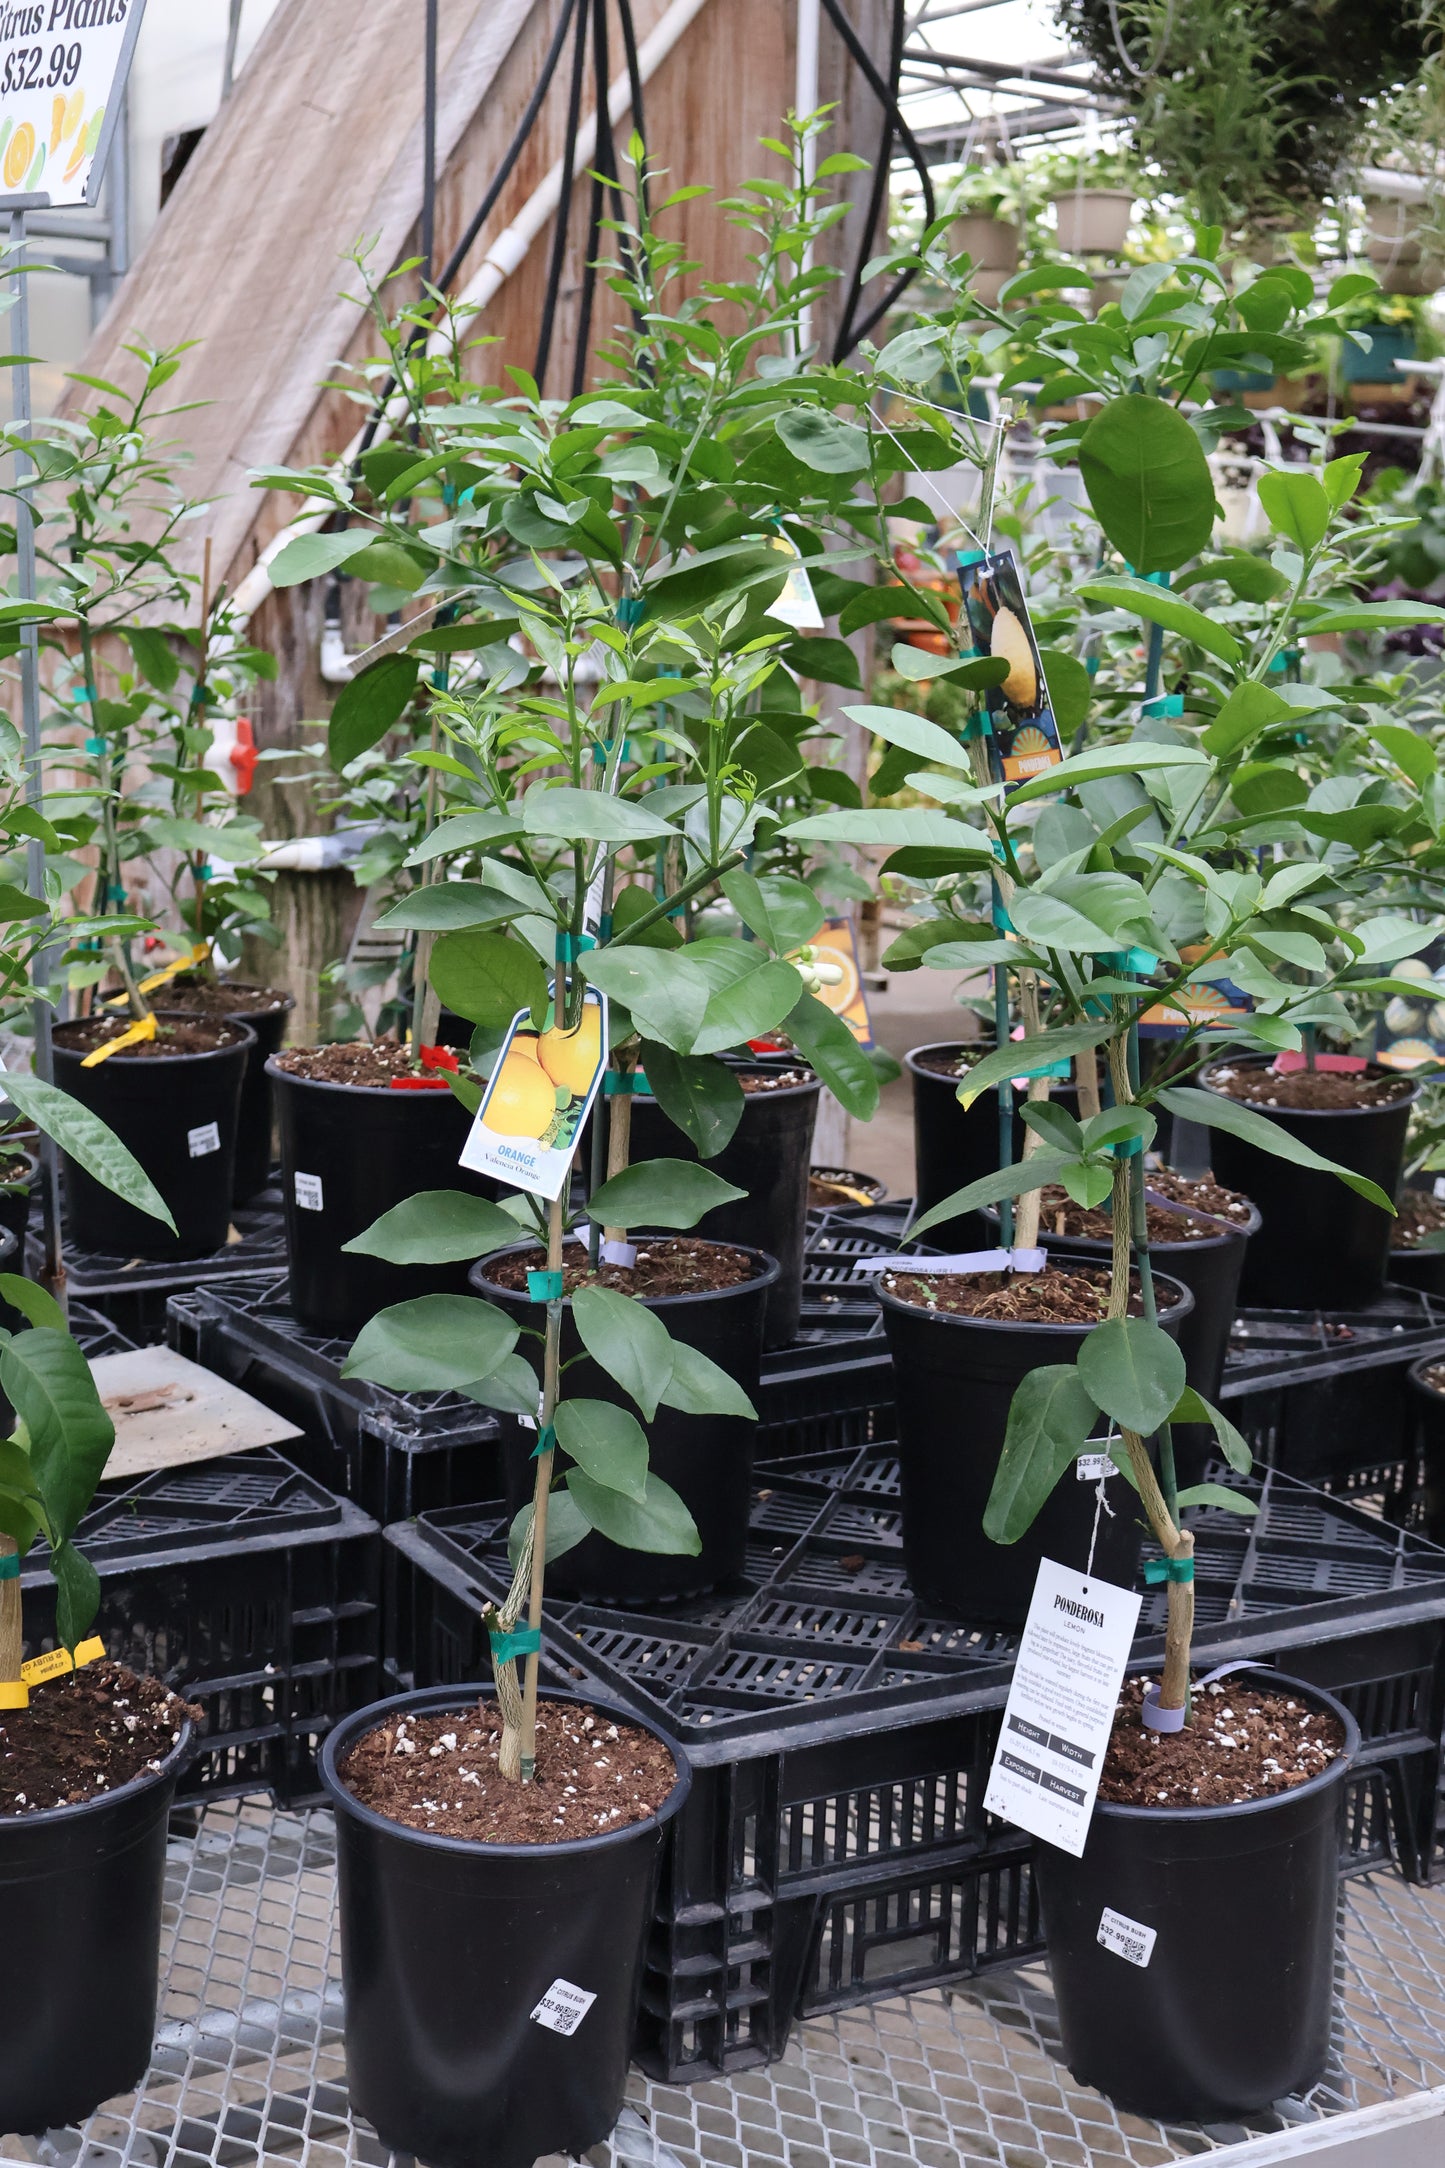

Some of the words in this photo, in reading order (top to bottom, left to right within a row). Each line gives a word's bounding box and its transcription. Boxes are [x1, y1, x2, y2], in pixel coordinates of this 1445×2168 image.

[0, 1, 44, 41] itrus
[47, 0, 128, 31] Plants
[1, 42, 82, 98] $32.99
[498, 1145, 536, 1167] ORANGE
[485, 1153, 514, 1170] Valencia
[515, 1164, 541, 1180] Orange
[1078, 1457, 1100, 1467] $32.99
[1054, 1594, 1104, 1628] PONDEROSA
[1063, 1620, 1085, 1634] LEMON
[1017, 1722, 1040, 1739] HEIGHT
[1061, 1743, 1082, 1759] WIDTH
[1005, 1757, 1036, 1779] EXPOSURE
[1050, 1780, 1080, 1800] HARVEST
[1100, 1923, 1125, 1942] $32.99
[1111, 1917, 1130, 1931] CITRUS
[557, 1989, 574, 2000] CITRUS
[540, 1998, 564, 2013] $32.99
